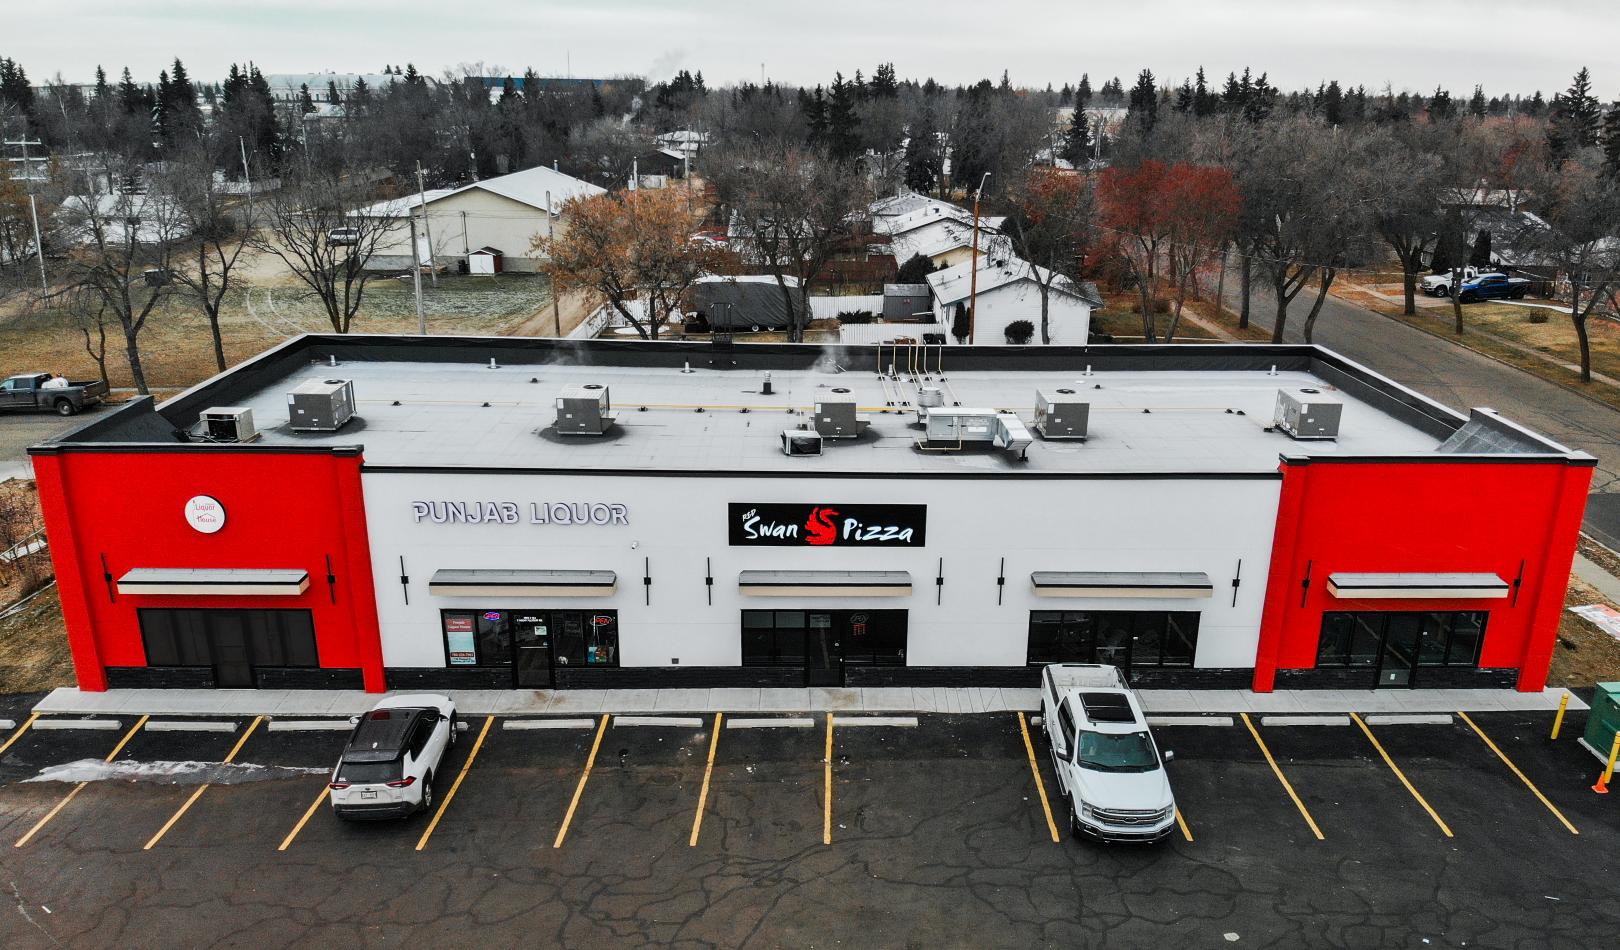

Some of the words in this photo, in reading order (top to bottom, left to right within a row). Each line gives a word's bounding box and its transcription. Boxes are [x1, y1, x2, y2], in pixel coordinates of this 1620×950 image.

[412, 501, 519, 524] PUNJAB
[530, 502, 629, 525] LIQUOR
[742, 508, 757, 522] RED
[743, 515, 798, 539] Swan
[843, 517, 914, 543] Pizza
